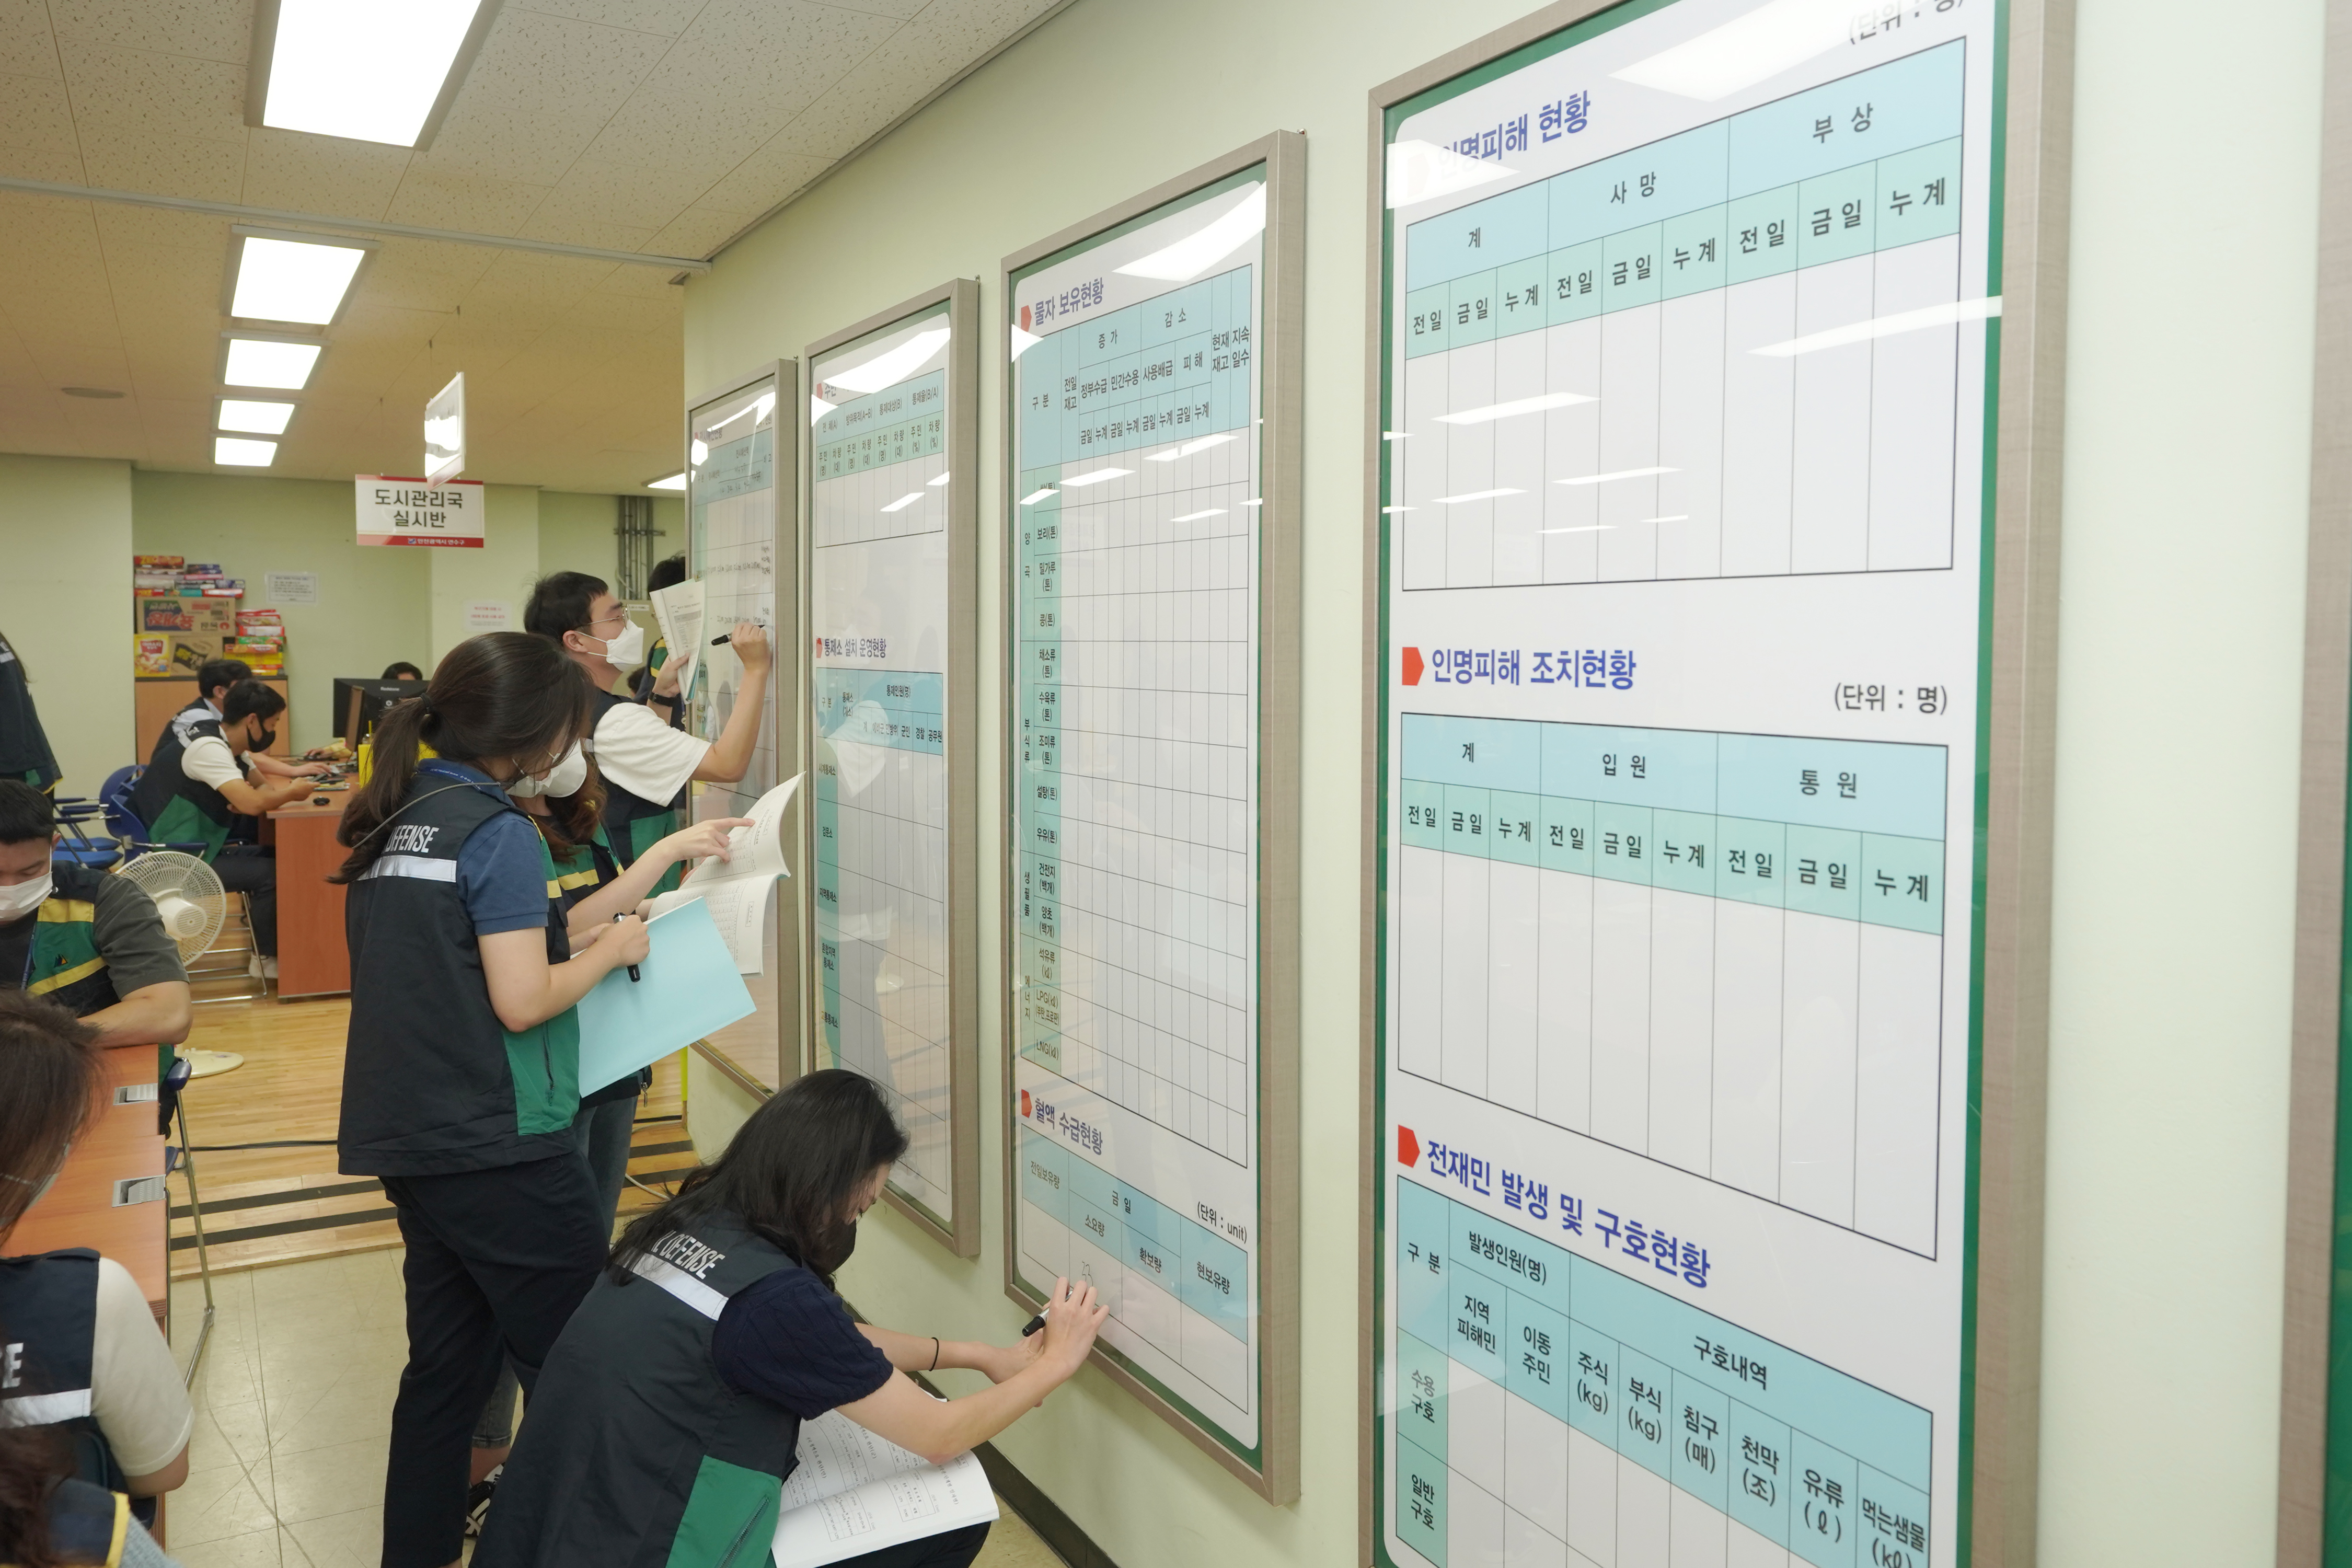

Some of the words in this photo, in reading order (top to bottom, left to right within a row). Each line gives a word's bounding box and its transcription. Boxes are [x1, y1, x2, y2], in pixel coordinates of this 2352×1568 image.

[1539, 90, 1590, 143] 현황
[1468, 227, 1481, 248] 계
[1413, 309, 1442, 336] 전일
[1457, 297, 1488, 325] 금일
[1505, 284, 1539, 312] 누계
[1557, 270, 1593, 299] 전일
[1612, 255, 1651, 286] 금일
[1673, 238, 1715, 270] 누계
[1739, 220, 1784, 253] 전일
[1812, 200, 1861, 237] 금일
[1890, 177, 1945, 216] 누계
[1034, 295, 1055, 326] 물자
[1058, 276, 1104, 316] 보유현황
[1064, 375, 1077, 393] 전일
[1081, 378, 1107, 399] 정부수급
[1143, 360, 1173, 381] 사용배급
[1183, 351, 1203, 371] 피해
[1212, 330, 1229, 351] 현재
[1232, 325, 1250, 345] 지속
[1064, 396, 1077, 411] 재고
[1212, 355, 1229, 372] 재고
[1232, 348, 1249, 368] 일수
[1081, 429, 1092, 445] 금일
[1096, 424, 1108, 442] 누계
[1111, 421, 1123, 439] 금일
[1126, 417, 1139, 435] 누계
[1143, 413, 1156, 432] 금일
[1159, 410, 1173, 428] 누계
[1177, 406, 1191, 424] 금일
[1194, 401, 1209, 420] 누계
[375, 489, 463, 508] 도시관리국
[394, 511, 446, 528] 실시반
[1037, 526, 1057, 540] 보리(톤)
[1040, 561, 1056, 575] 밀가루
[1043, 578, 1052, 592] (톤)
[1040, 613, 1055, 627] 콩(톤)
[825, 639, 843, 656] 통제소
[845, 639, 857, 657] 설치
[859, 638, 886, 659] 운영현황
[1039, 649, 1055, 662] 채소류
[1042, 665, 1052, 679] (톤)
[1432, 649, 1520, 686] 인명피해
[1530, 649, 1636, 690] 조치현황
[886, 685, 910, 698] 통제인원(명)
[1039, 691, 1055, 705] 수육류
[1835, 683, 1885, 711] (단위
[1042, 708, 1052, 722] (톤)
[901, 725, 910, 737] 군인
[916, 727, 924, 740] 경찰
[928, 730, 942, 743] 공무원
[1039, 735, 1055, 748] 조미류
[1042, 751, 1052, 765] (톤)
[1462, 742, 1474, 763] 계
[1602, 754, 1646, 779] 입원
[1800, 769, 1857, 799] 통원
[1037, 785, 1057, 801] 설탕(톤)
[385, 825, 440, 853] DEFENSE
[1037, 828, 1057, 845] 우유(톤)
[1409, 805, 1436, 827] 전일
[1451, 811, 1482, 835] 금일
[1498, 818, 1531, 843] 누계
[1550, 825, 1584, 850] 전일
[1603, 832, 1641, 859] 금일
[1664, 840, 1704, 868] 누계
[1728, 850, 1772, 878] 전일
[1798, 859, 1847, 890] 금일
[1875, 870, 1928, 902] 누계
[1039, 863, 1055, 879] 건전지
[1040, 879, 1054, 895] (백개)
[1042, 906, 1052, 920] 양초
[1040, 921, 1054, 938] (백개)
[1039, 948, 1055, 964] 석유류
[1035, 1098, 1055, 1129] 혈액
[1059, 1111, 1103, 1156] 수급현황
[1030, 1160, 1060, 1190] 전일보유량
[1427, 1140, 1490, 1197] 전재민
[1502, 1169, 1548, 1221] 발생
[1561, 1193, 1582, 1236] 및
[1595, 1207, 1711, 1289] 구호현황
[1227, 1221, 1248, 1244] unit)
[659, 1233, 725, 1279] DEFENSE
[1085, 1214, 1104, 1237] 소요량
[1139, 1248, 1161, 1274] 확보량
[1196, 1261, 1230, 1295] 현보유량
[1468, 1230, 1546, 1286] 발생인원(명)
[1464, 1295, 1489, 1324] 지역
[1457, 1318, 1495, 1355] 피해민
[1524, 1326, 1551, 1356] 이동
[1523, 1353, 1550, 1385] 주민
[1694, 1335, 1767, 1390] 구호내역
[1411, 1368, 1435, 1399] 수용
[1411, 1393, 1435, 1423] 구호
[1577, 1379, 1608, 1415] (kg)
[1628, 1406, 1661, 1444] (kg)
[1577, 1352, 1608, 1386] 주식
[1629, 1377, 1661, 1414] 부식
[1684, 1405, 1719, 1441] 침구
[1742, 1436, 1779, 1475] 천막
[1803, 1469, 1844, 1508] 유류
[1862, 1498, 1926, 1553] 먹는샘물
[1685, 1437, 1715, 1474] (매)
[1743, 1468, 1775, 1507] (조)
[1411, 1473, 1435, 1505] 일반
[1411, 1499, 1434, 1530] 구호
